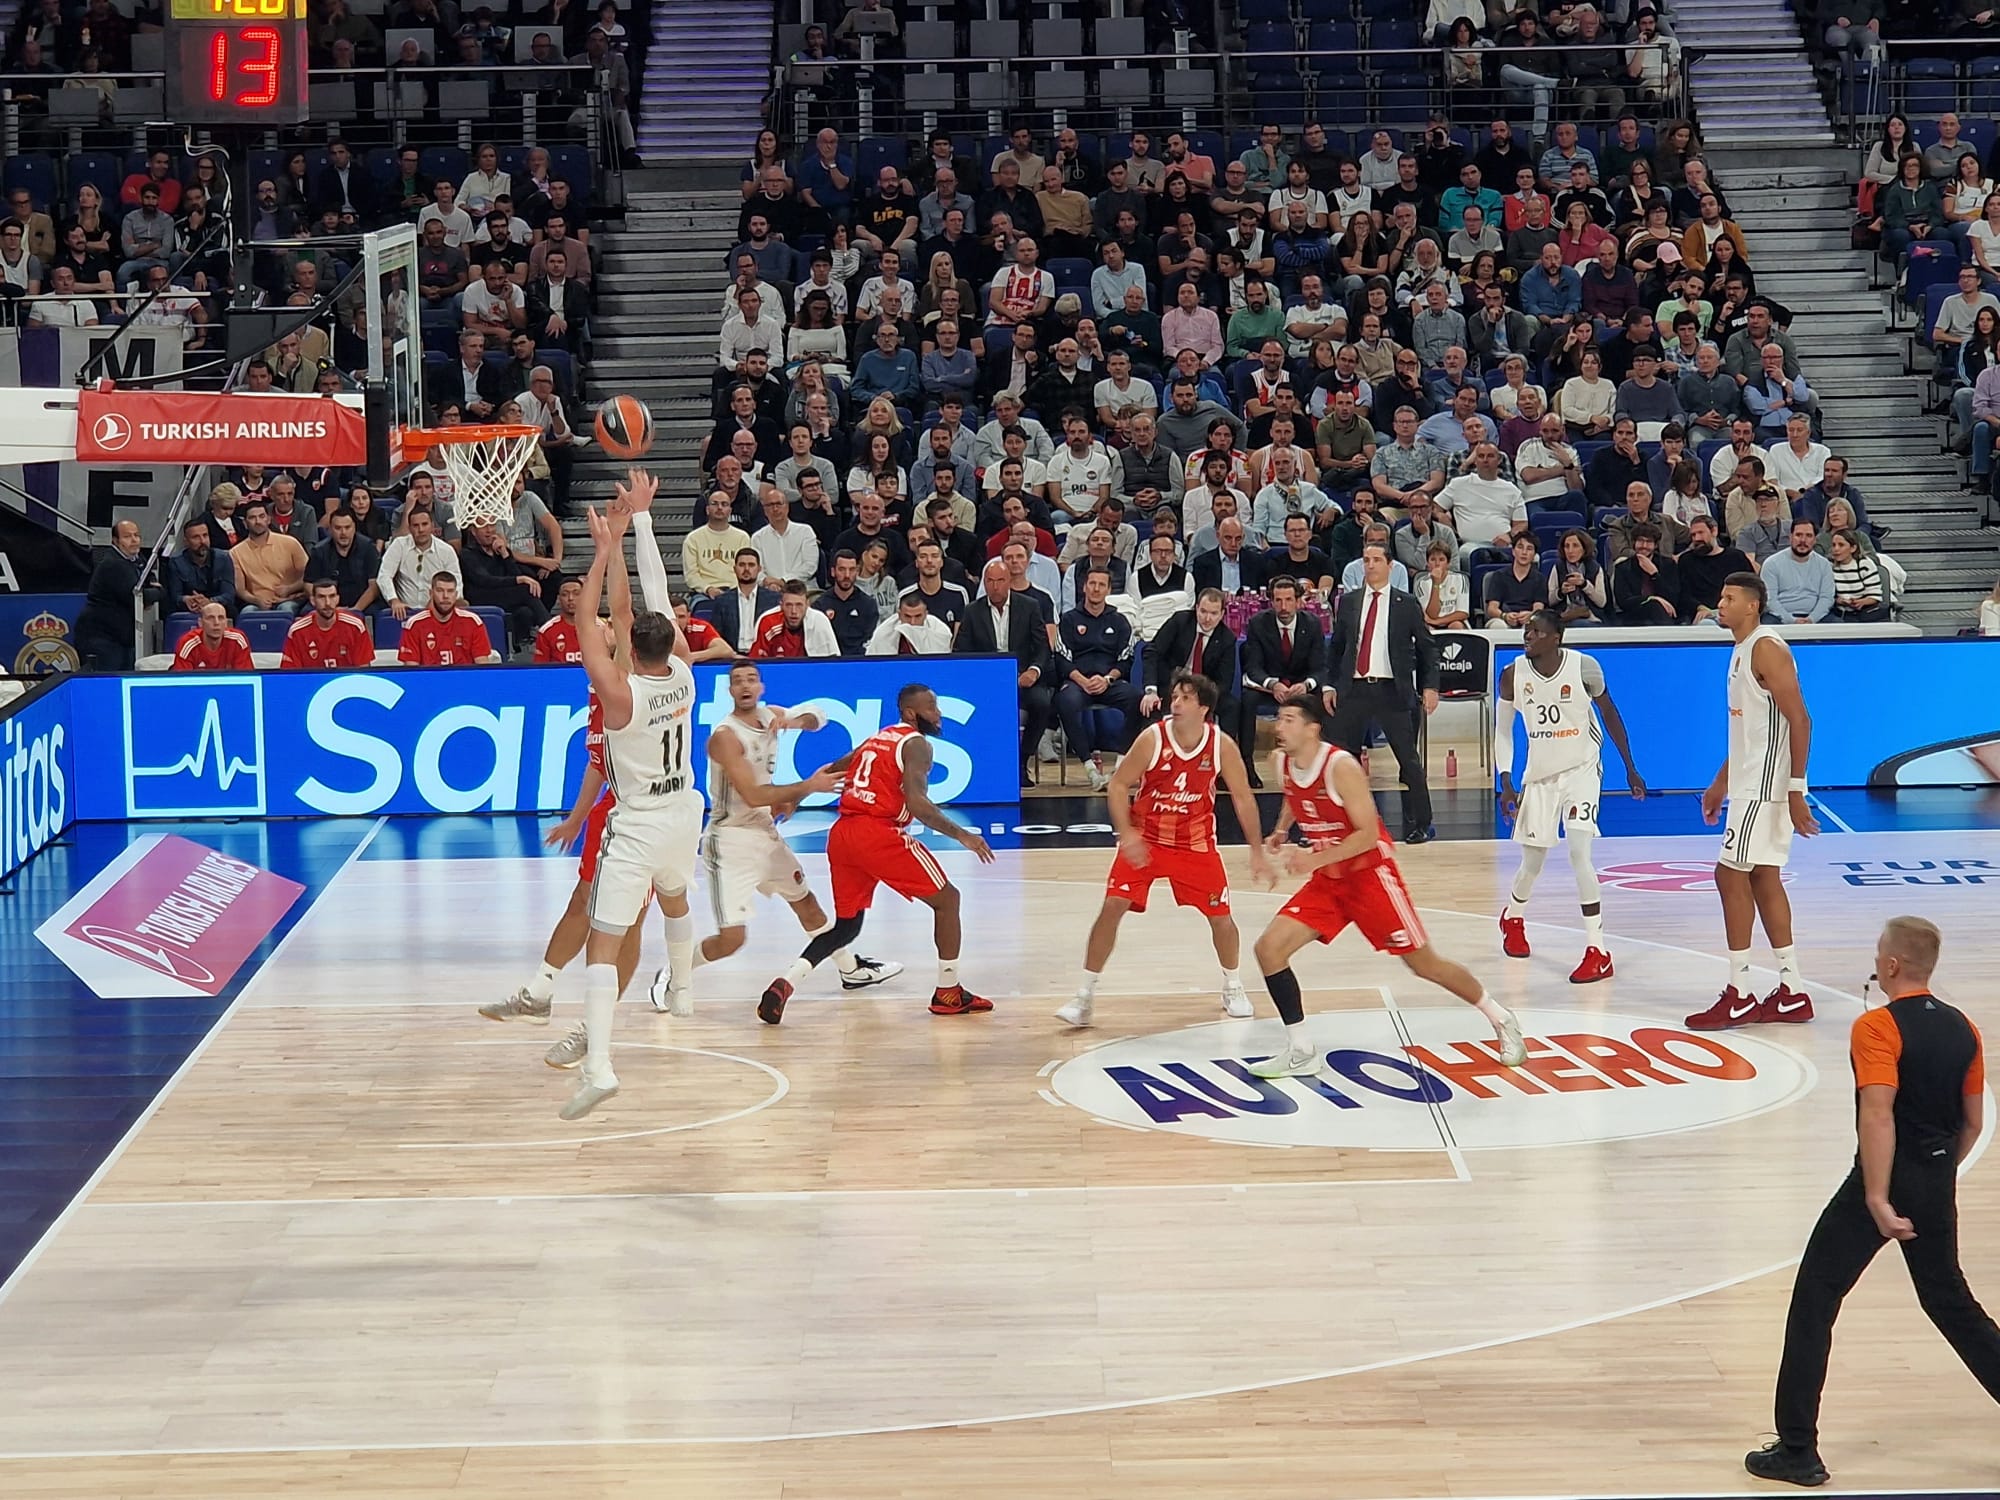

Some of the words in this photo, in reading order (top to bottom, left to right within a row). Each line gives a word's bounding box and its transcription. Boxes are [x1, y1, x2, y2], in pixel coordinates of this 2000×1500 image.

[211, 27, 280, 106] 13
[140, 423, 230, 440] TURKISH
[235, 421, 327, 439] AIRLINES
[88, 470, 153, 529] F
[1440, 660, 1473, 673] nicaja
[1536, 704, 1561, 725] 30
[660, 723, 683, 777] 11
[853, 749, 878, 788] 0
[0, 717, 65, 882] itas
[1173, 772, 1188, 791] 4
[1722, 827, 1736, 850] 2
[135, 890, 223, 949] TURKISH
[179, 851, 259, 909] AIRLINES
